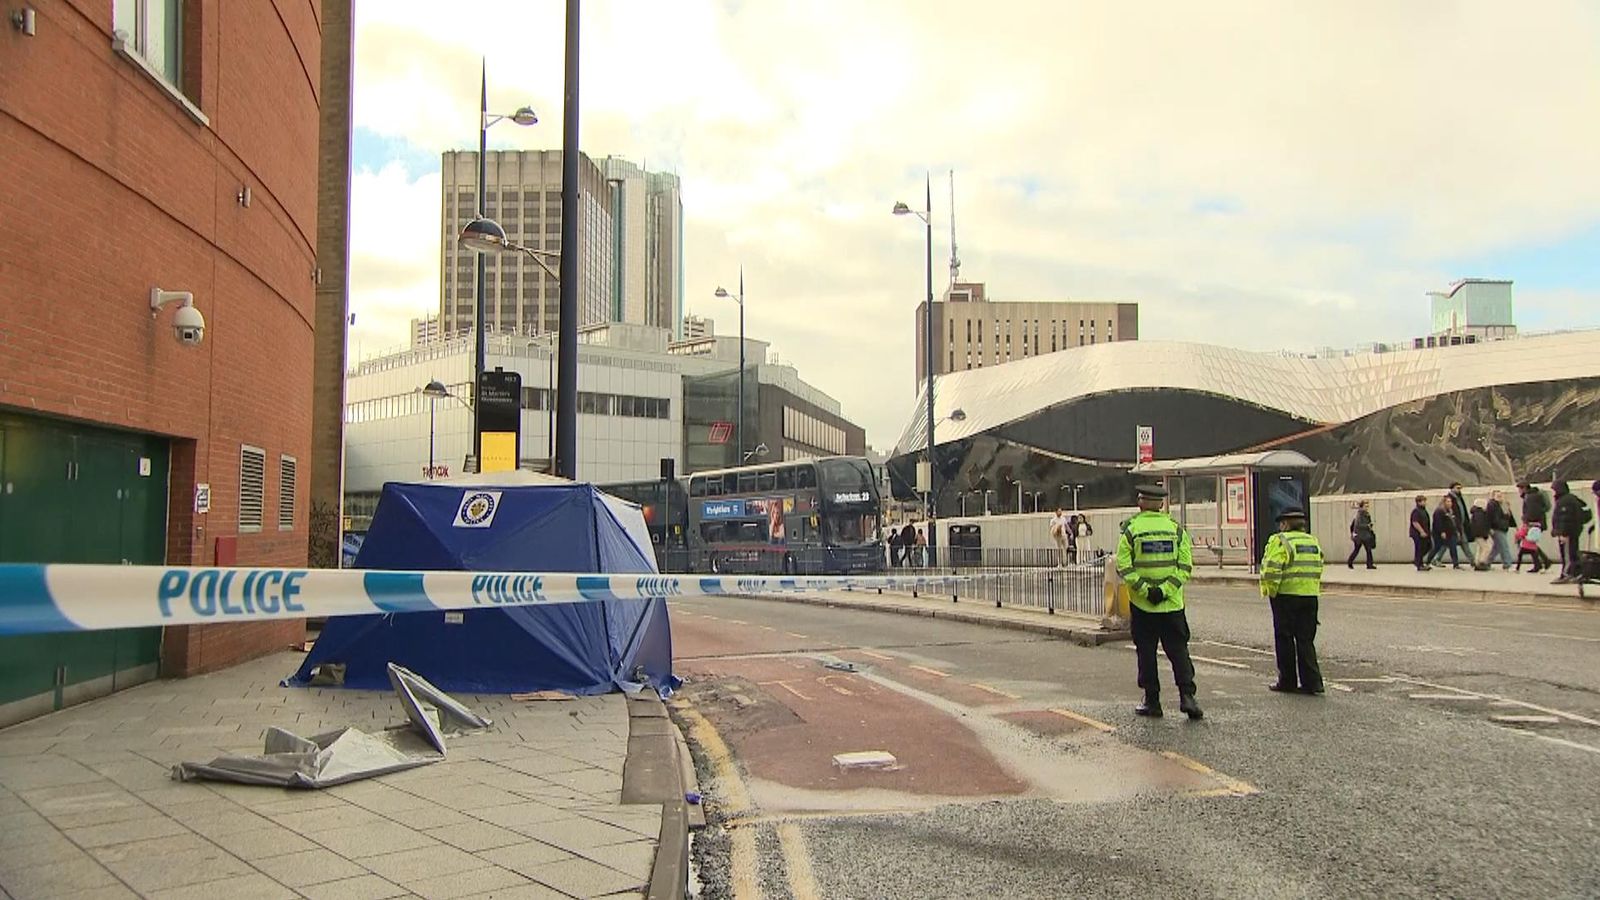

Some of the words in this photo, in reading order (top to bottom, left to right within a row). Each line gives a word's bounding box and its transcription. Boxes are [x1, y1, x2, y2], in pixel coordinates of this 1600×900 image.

[158, 569, 308, 618] POLICE
[471, 575, 547, 604] POLICE
[636, 577, 681, 597] POLICE
